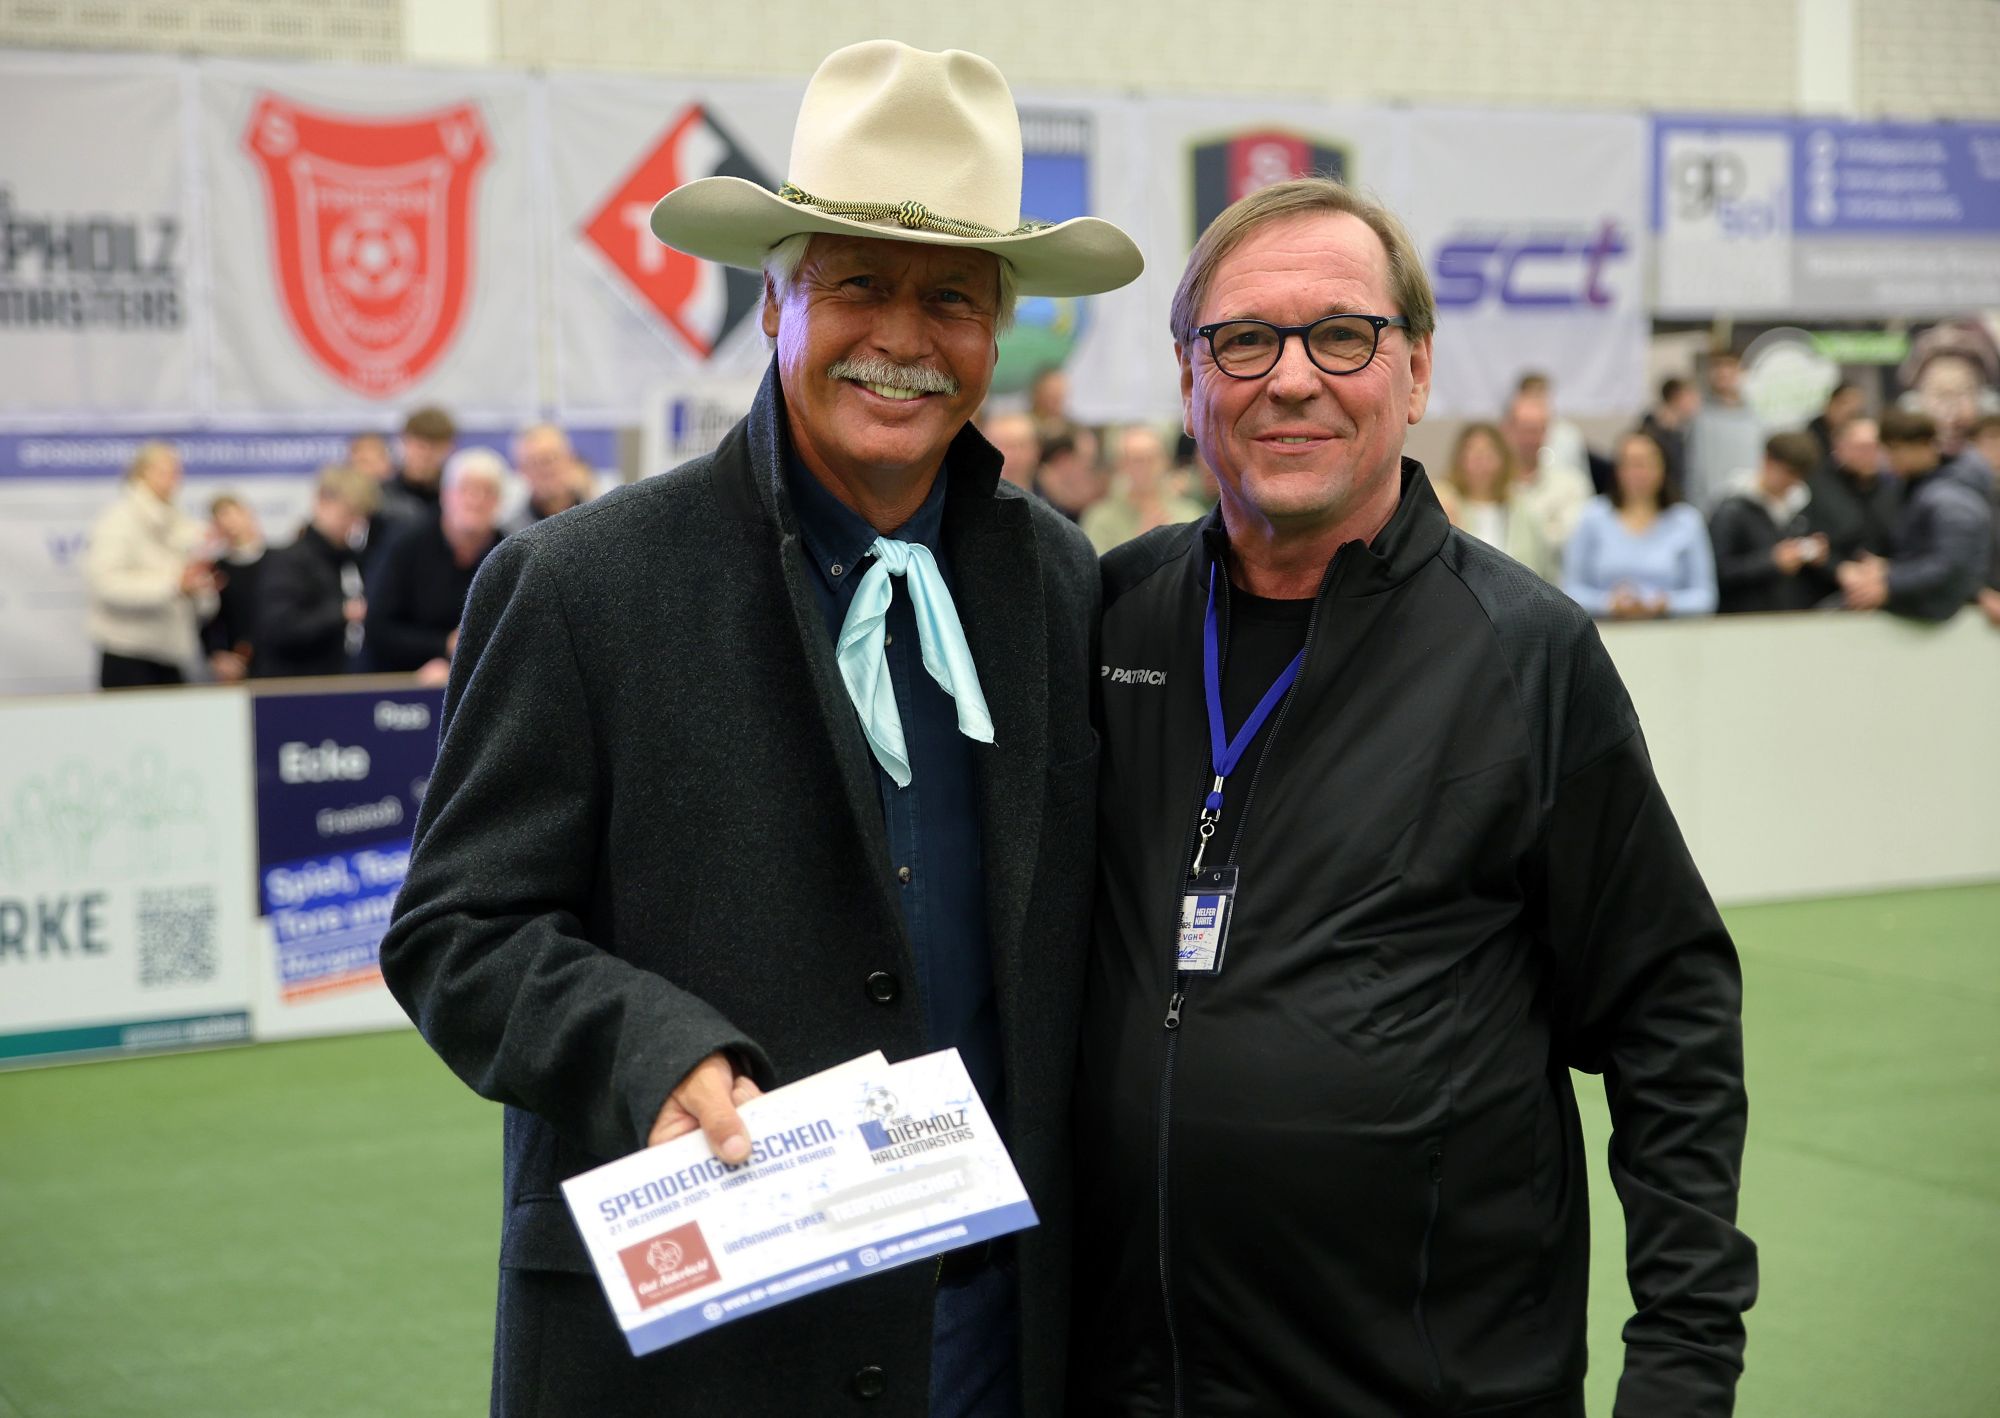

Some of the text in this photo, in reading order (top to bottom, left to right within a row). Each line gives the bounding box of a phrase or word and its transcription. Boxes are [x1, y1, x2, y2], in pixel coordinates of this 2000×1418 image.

[0, 219, 177, 276] PHOLZ
[1111, 667, 1168, 686] PATRICK
[281, 741, 369, 782] Ecke
[1194, 917, 1213, 926] KARTE
[1197, 908, 1216, 917] HELFER
[1183, 933, 1198, 941] VGH
[888, 1109, 969, 1145] DIEPHOLZ
[871, 1127, 975, 1166] HALLENMASTERS
[598, 1118, 837, 1223] SPENDENGSCHEIN
